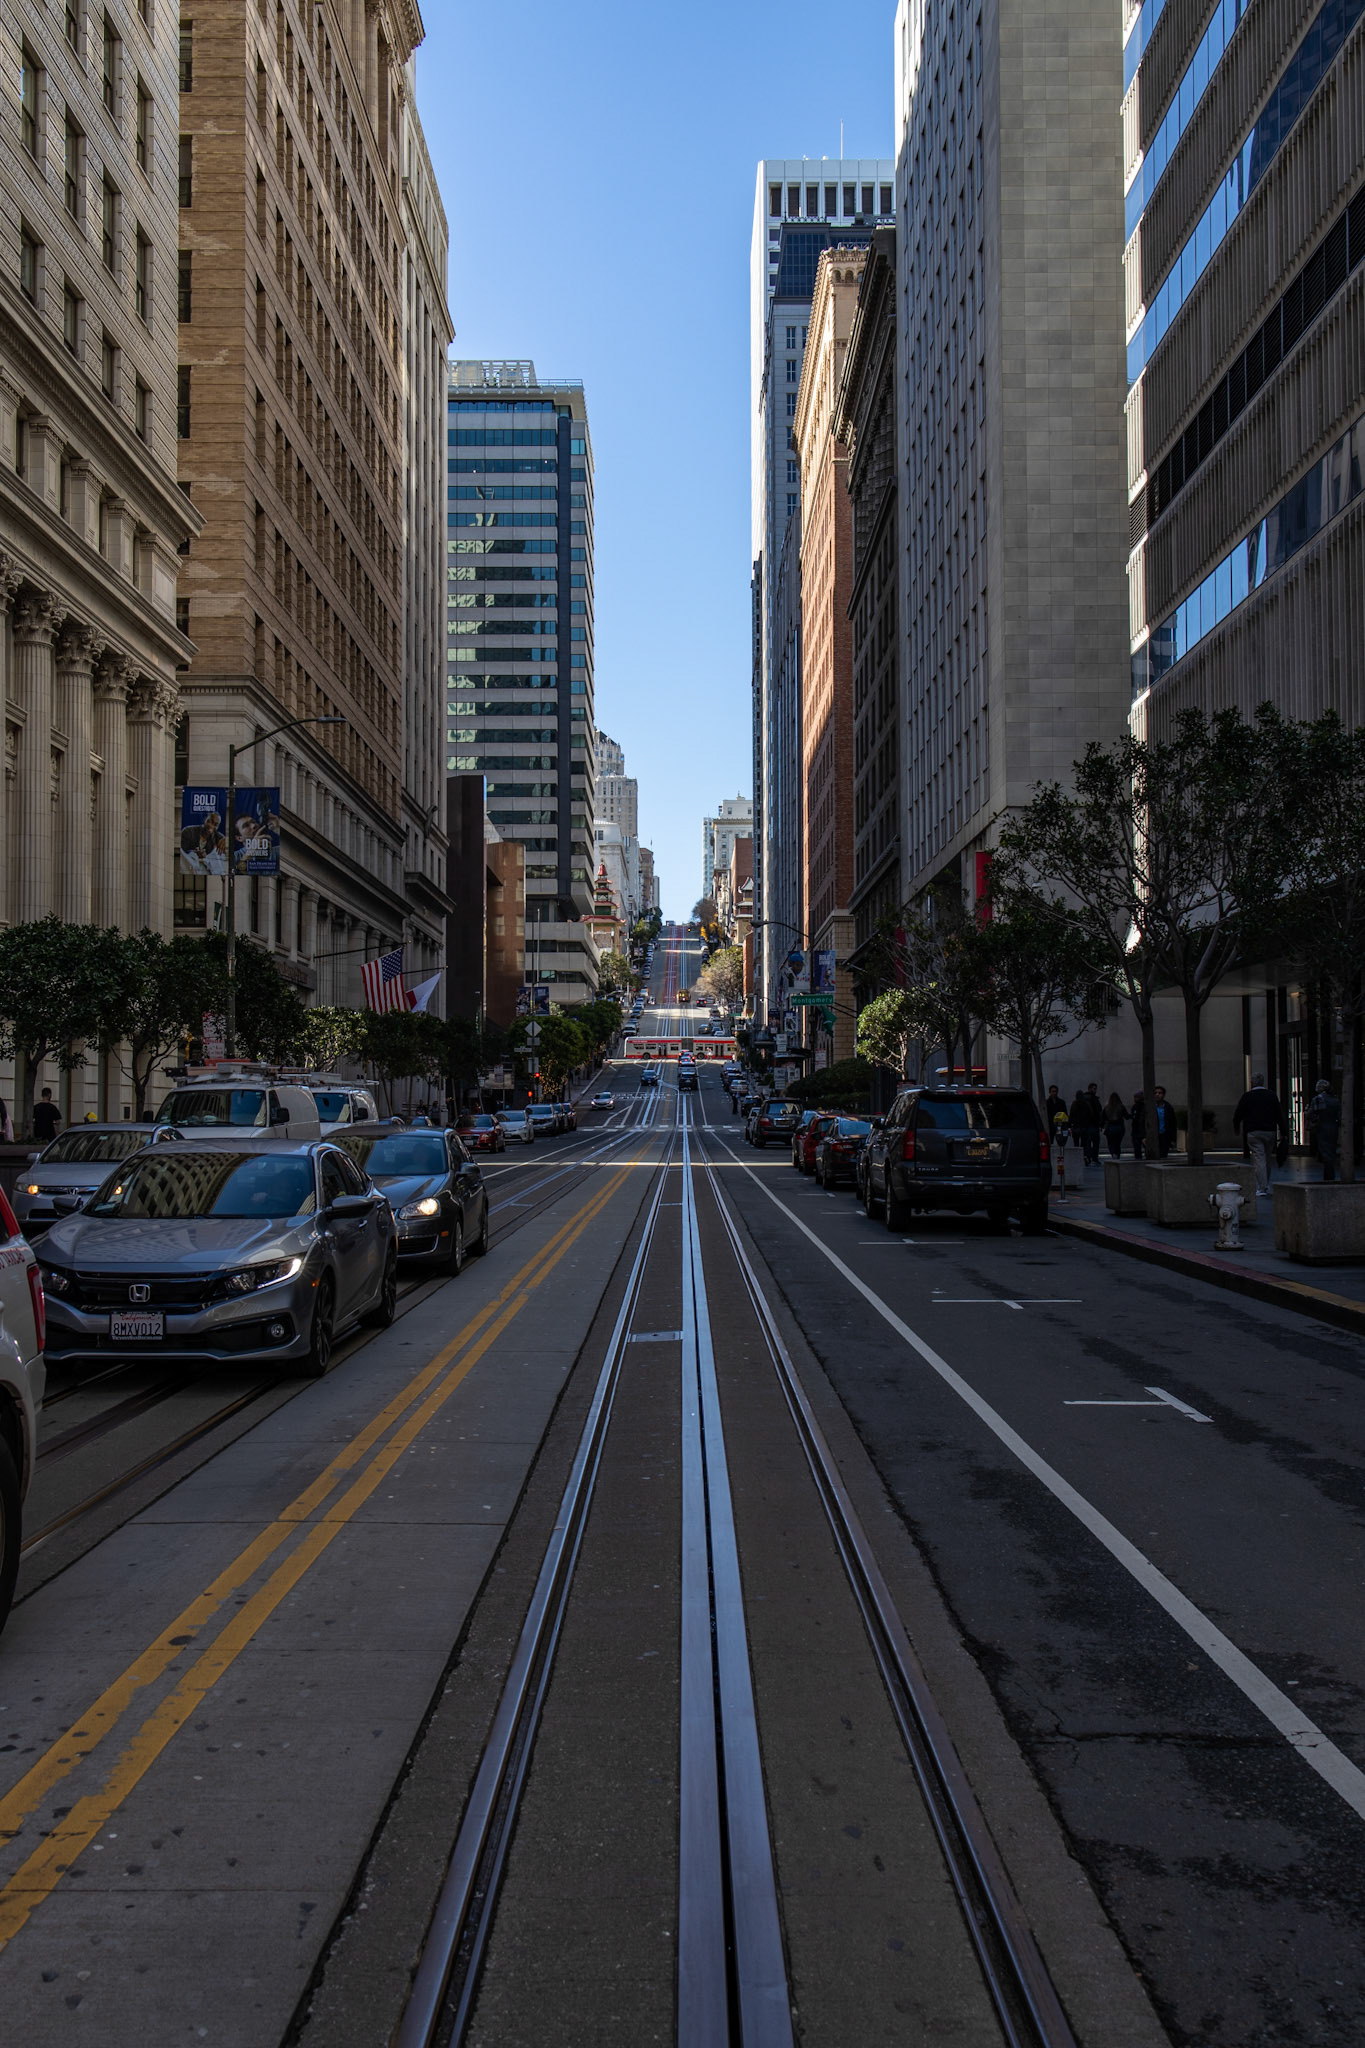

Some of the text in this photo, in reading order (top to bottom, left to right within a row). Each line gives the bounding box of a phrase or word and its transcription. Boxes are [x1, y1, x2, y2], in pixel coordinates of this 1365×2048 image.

[193, 794, 216, 805] BOLD
[245, 839, 268, 849] BOLD
[246, 849, 268, 857] ANSWERS
[792, 996, 832, 1005] Montgomery
[113, 1323, 161, 1336] 8MXV012
